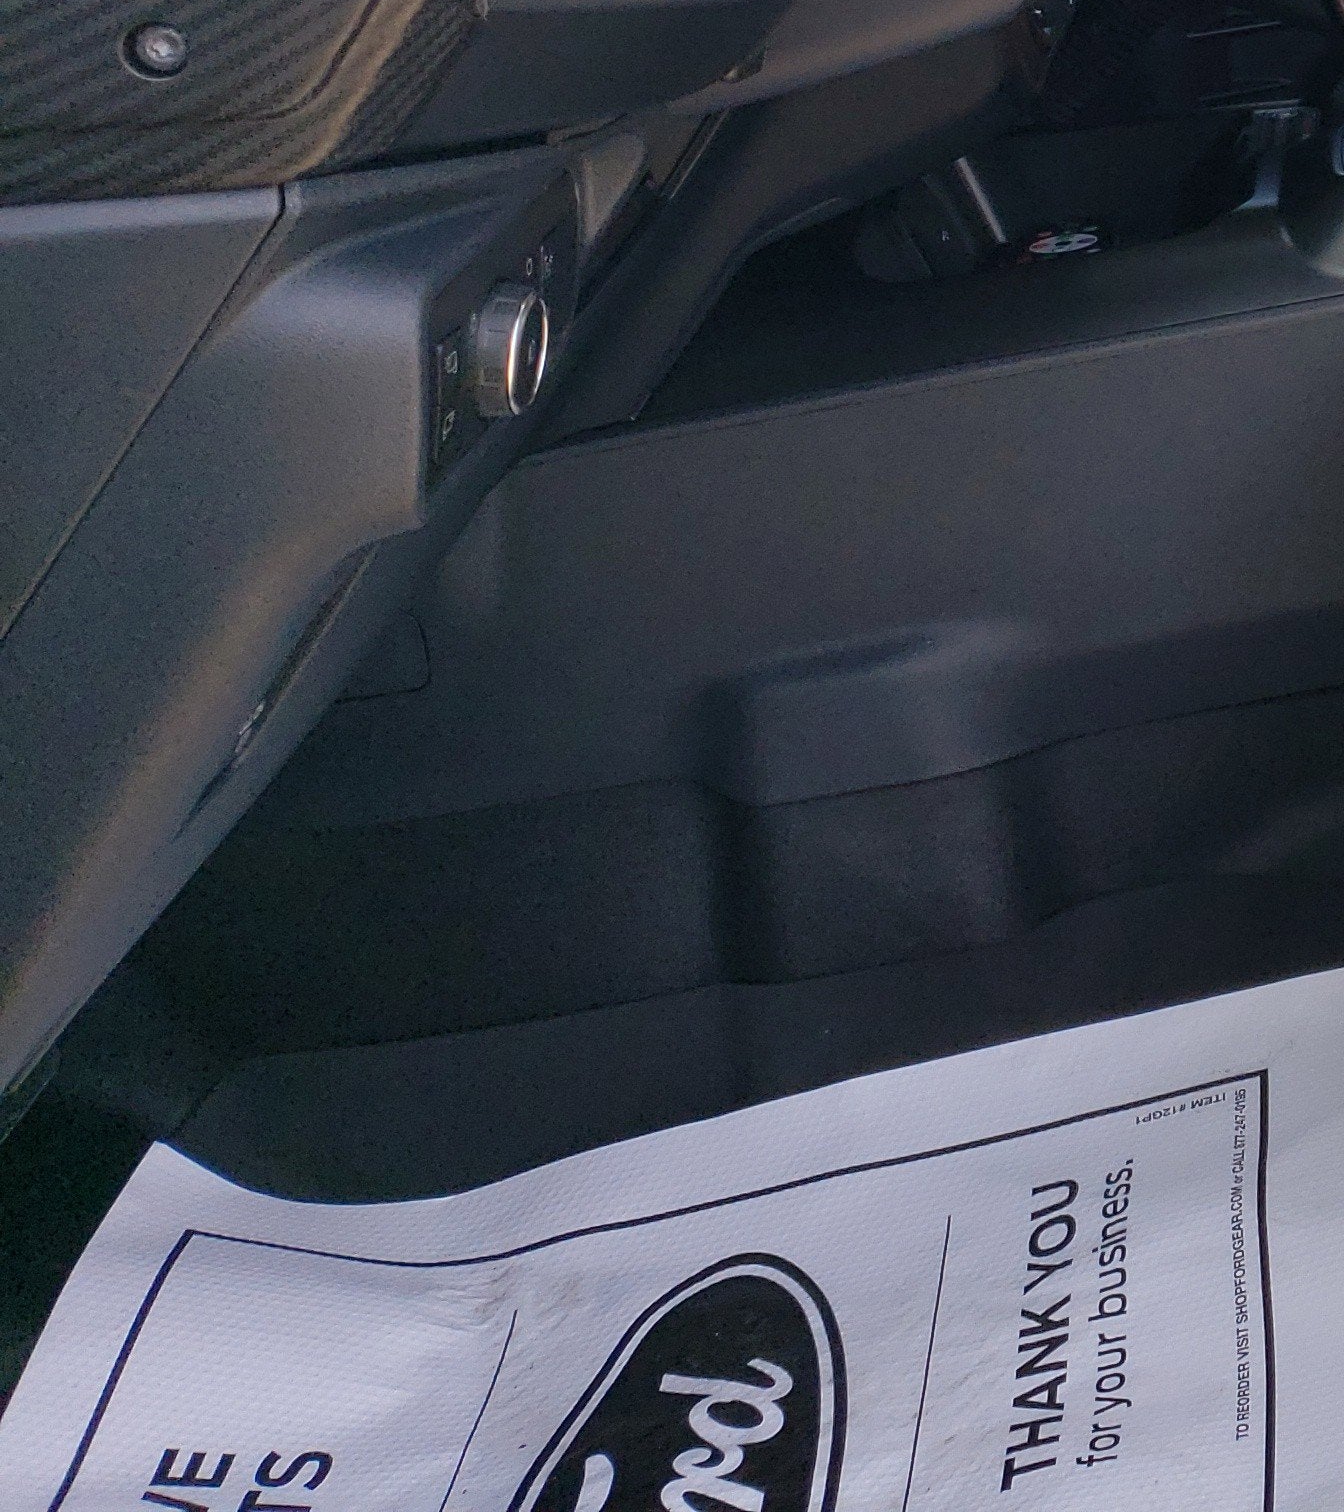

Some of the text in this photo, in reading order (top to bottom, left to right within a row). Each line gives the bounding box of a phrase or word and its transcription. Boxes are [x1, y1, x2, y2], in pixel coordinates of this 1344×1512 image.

[1135, 1092, 1226, 1125] ITEM #12GP1
[1232, 1149, 1245, 1174] CALL
[1230, 1186, 1248, 1324] SHOPFORDGEAR.COM
[1000, 1179, 1079, 1493] THANK YOU
[1075, 1158, 1134, 1467] for your business.
[1236, 1328, 1249, 1361] VISIT
[1237, 1361, 1250, 1422] REORDER
[1236, 1423, 1249, 1441] TO
